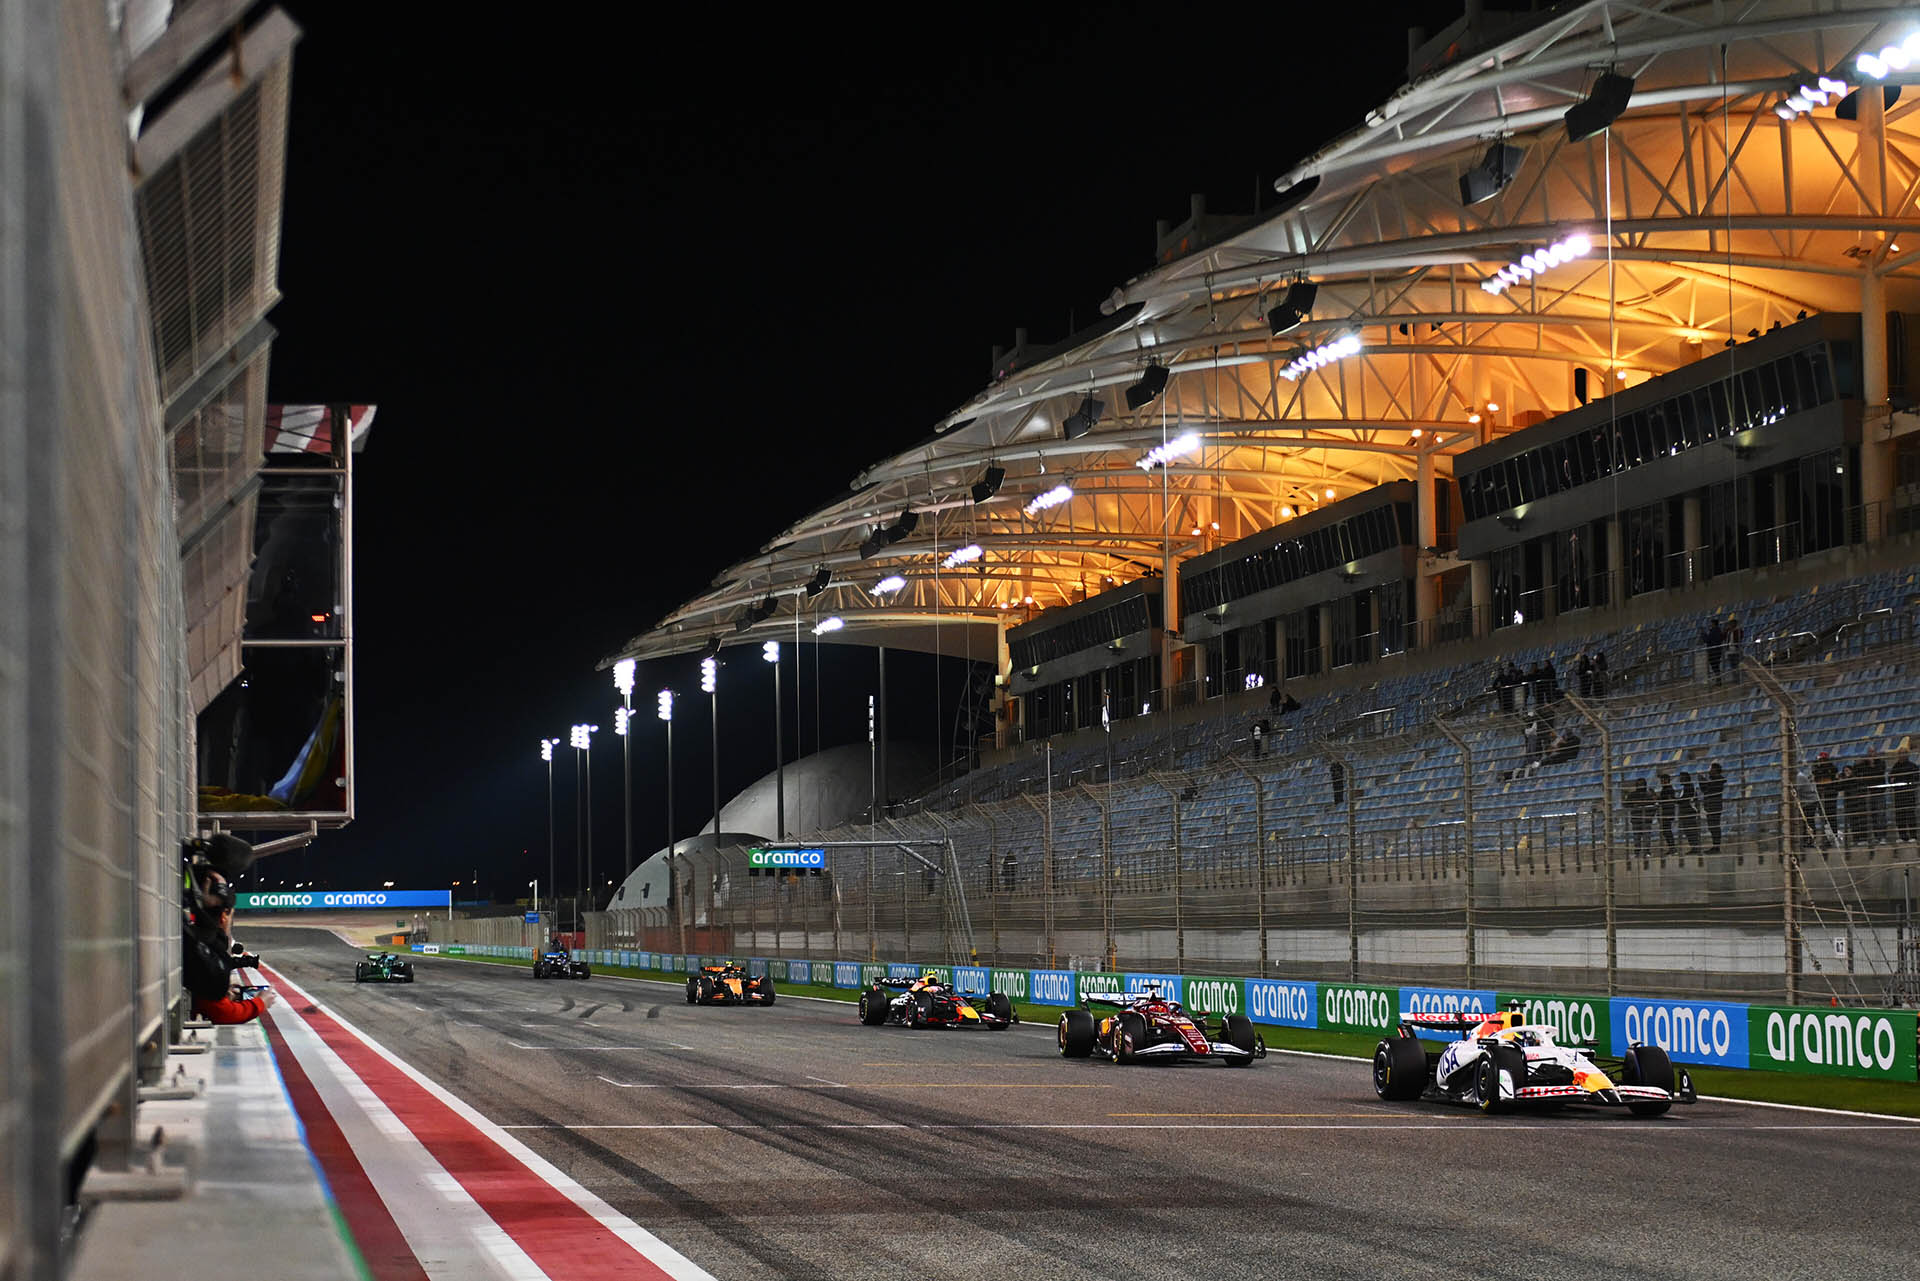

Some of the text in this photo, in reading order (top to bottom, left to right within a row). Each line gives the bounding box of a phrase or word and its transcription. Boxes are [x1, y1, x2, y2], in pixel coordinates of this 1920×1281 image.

[752, 853, 820, 864] aramco
[250, 893, 386, 906] aramco aramco
[956, 970, 985, 995] aramco
[993, 972, 1025, 998] aramco
[1034, 974, 1070, 1000] aramco
[1189, 981, 1238, 1014] aramco
[1253, 984, 1308, 1021] aramco
[1325, 988, 1390, 1028] aramco
[1413, 1013, 1450, 1022] Red
[1509, 999, 1595, 1045] ramco
[1625, 1005, 1730, 1056] aramco
[1767, 1012, 1895, 1070] aramco
[1522, 1086, 1579, 1098] HUGO
